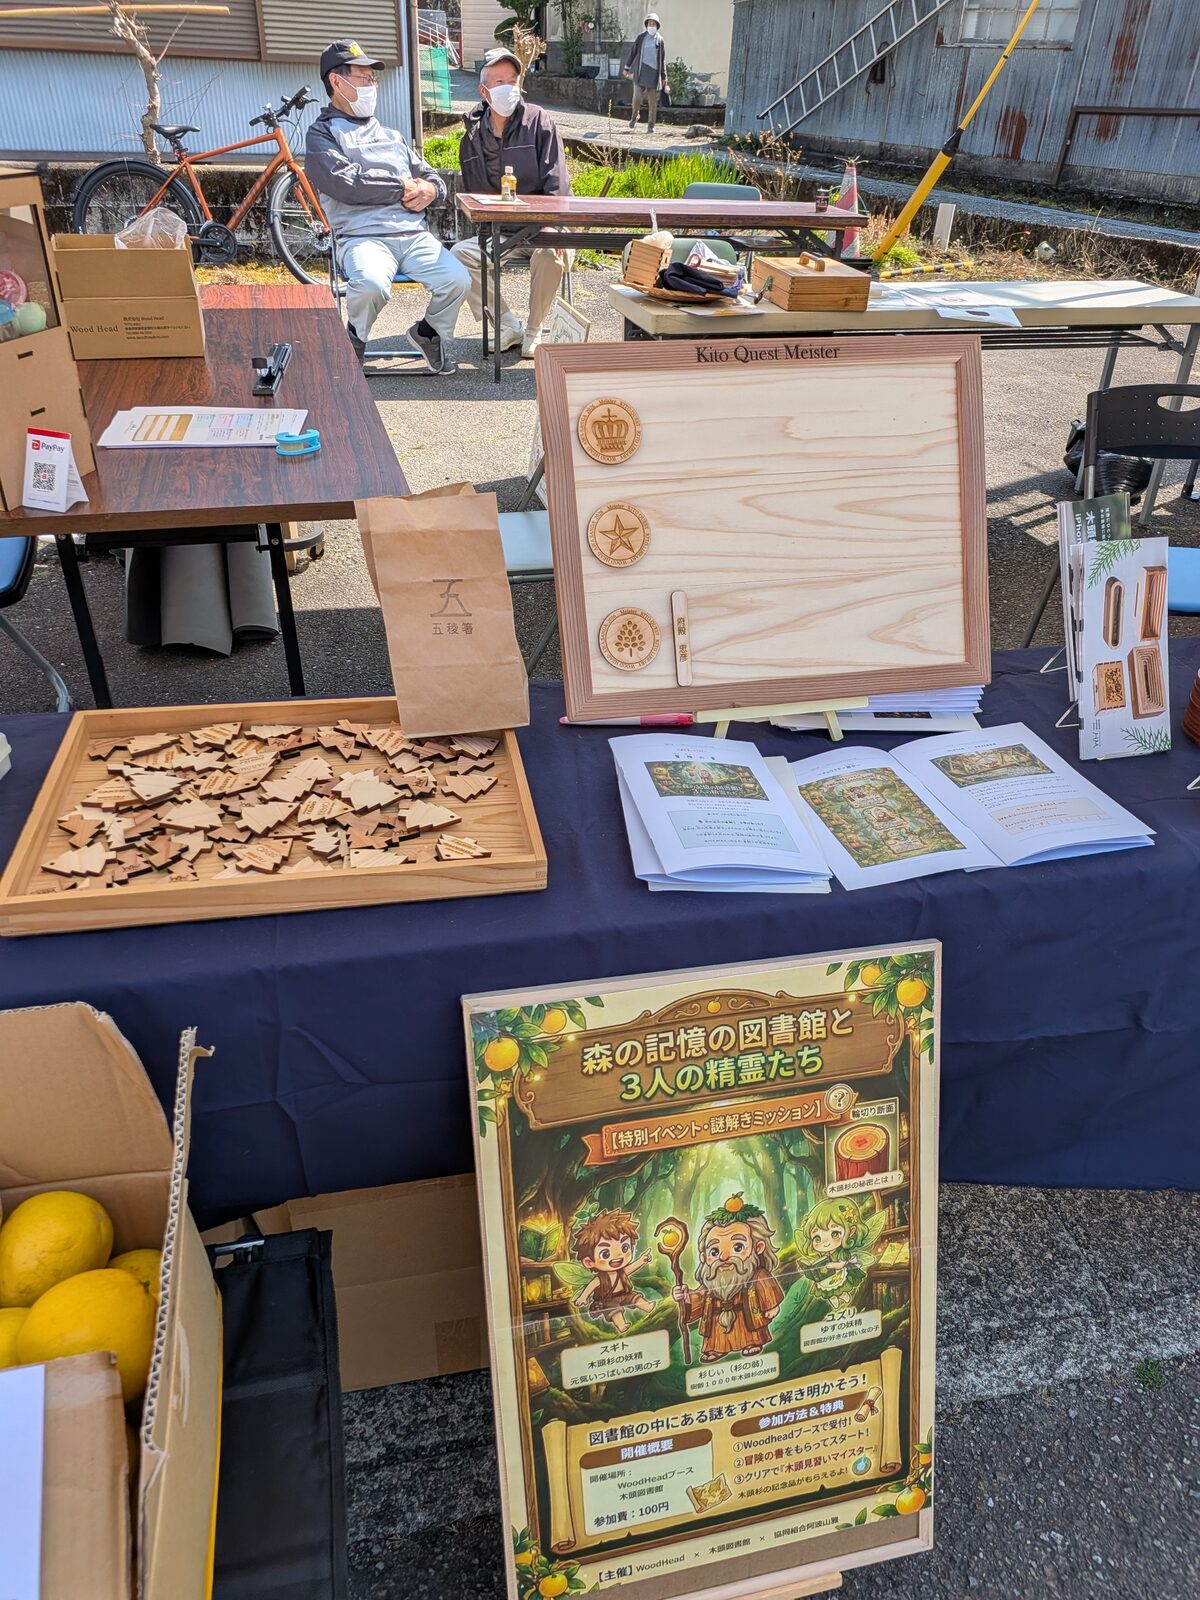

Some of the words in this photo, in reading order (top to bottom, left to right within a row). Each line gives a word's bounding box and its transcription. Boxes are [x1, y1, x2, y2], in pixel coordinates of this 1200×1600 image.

[69, 325, 94, 334] Wood
[97, 325, 119, 333] Head
[694, 346, 728, 363] Kito
[734, 345, 780, 363] Quest
[783, 344, 840, 360] Meister
[41, 442, 65, 453] PayPay
[1085, 510, 1096, 543] 木頭
[582, 1008, 853, 1075] 森の記憶の図書館と
[620, 1045, 824, 1101] 3人の精霊たち
[852, 1103, 895, 1119] 輪切り断面
[610, 1099, 821, 1150] 【特別イベント・謎解きミッション】
[600, 1341, 630, 1355] スギト
[587, 1351, 644, 1370] 木頭杉の妖精
[589, 1374, 867, 1447] 図書館の中にある謎をすべて解き明かそう！
[621, 1439, 674, 1460] 開催概要
[617, 1466, 694, 1490] WoodHeadブース
[636, 1554, 686, 1573] WoodHead
